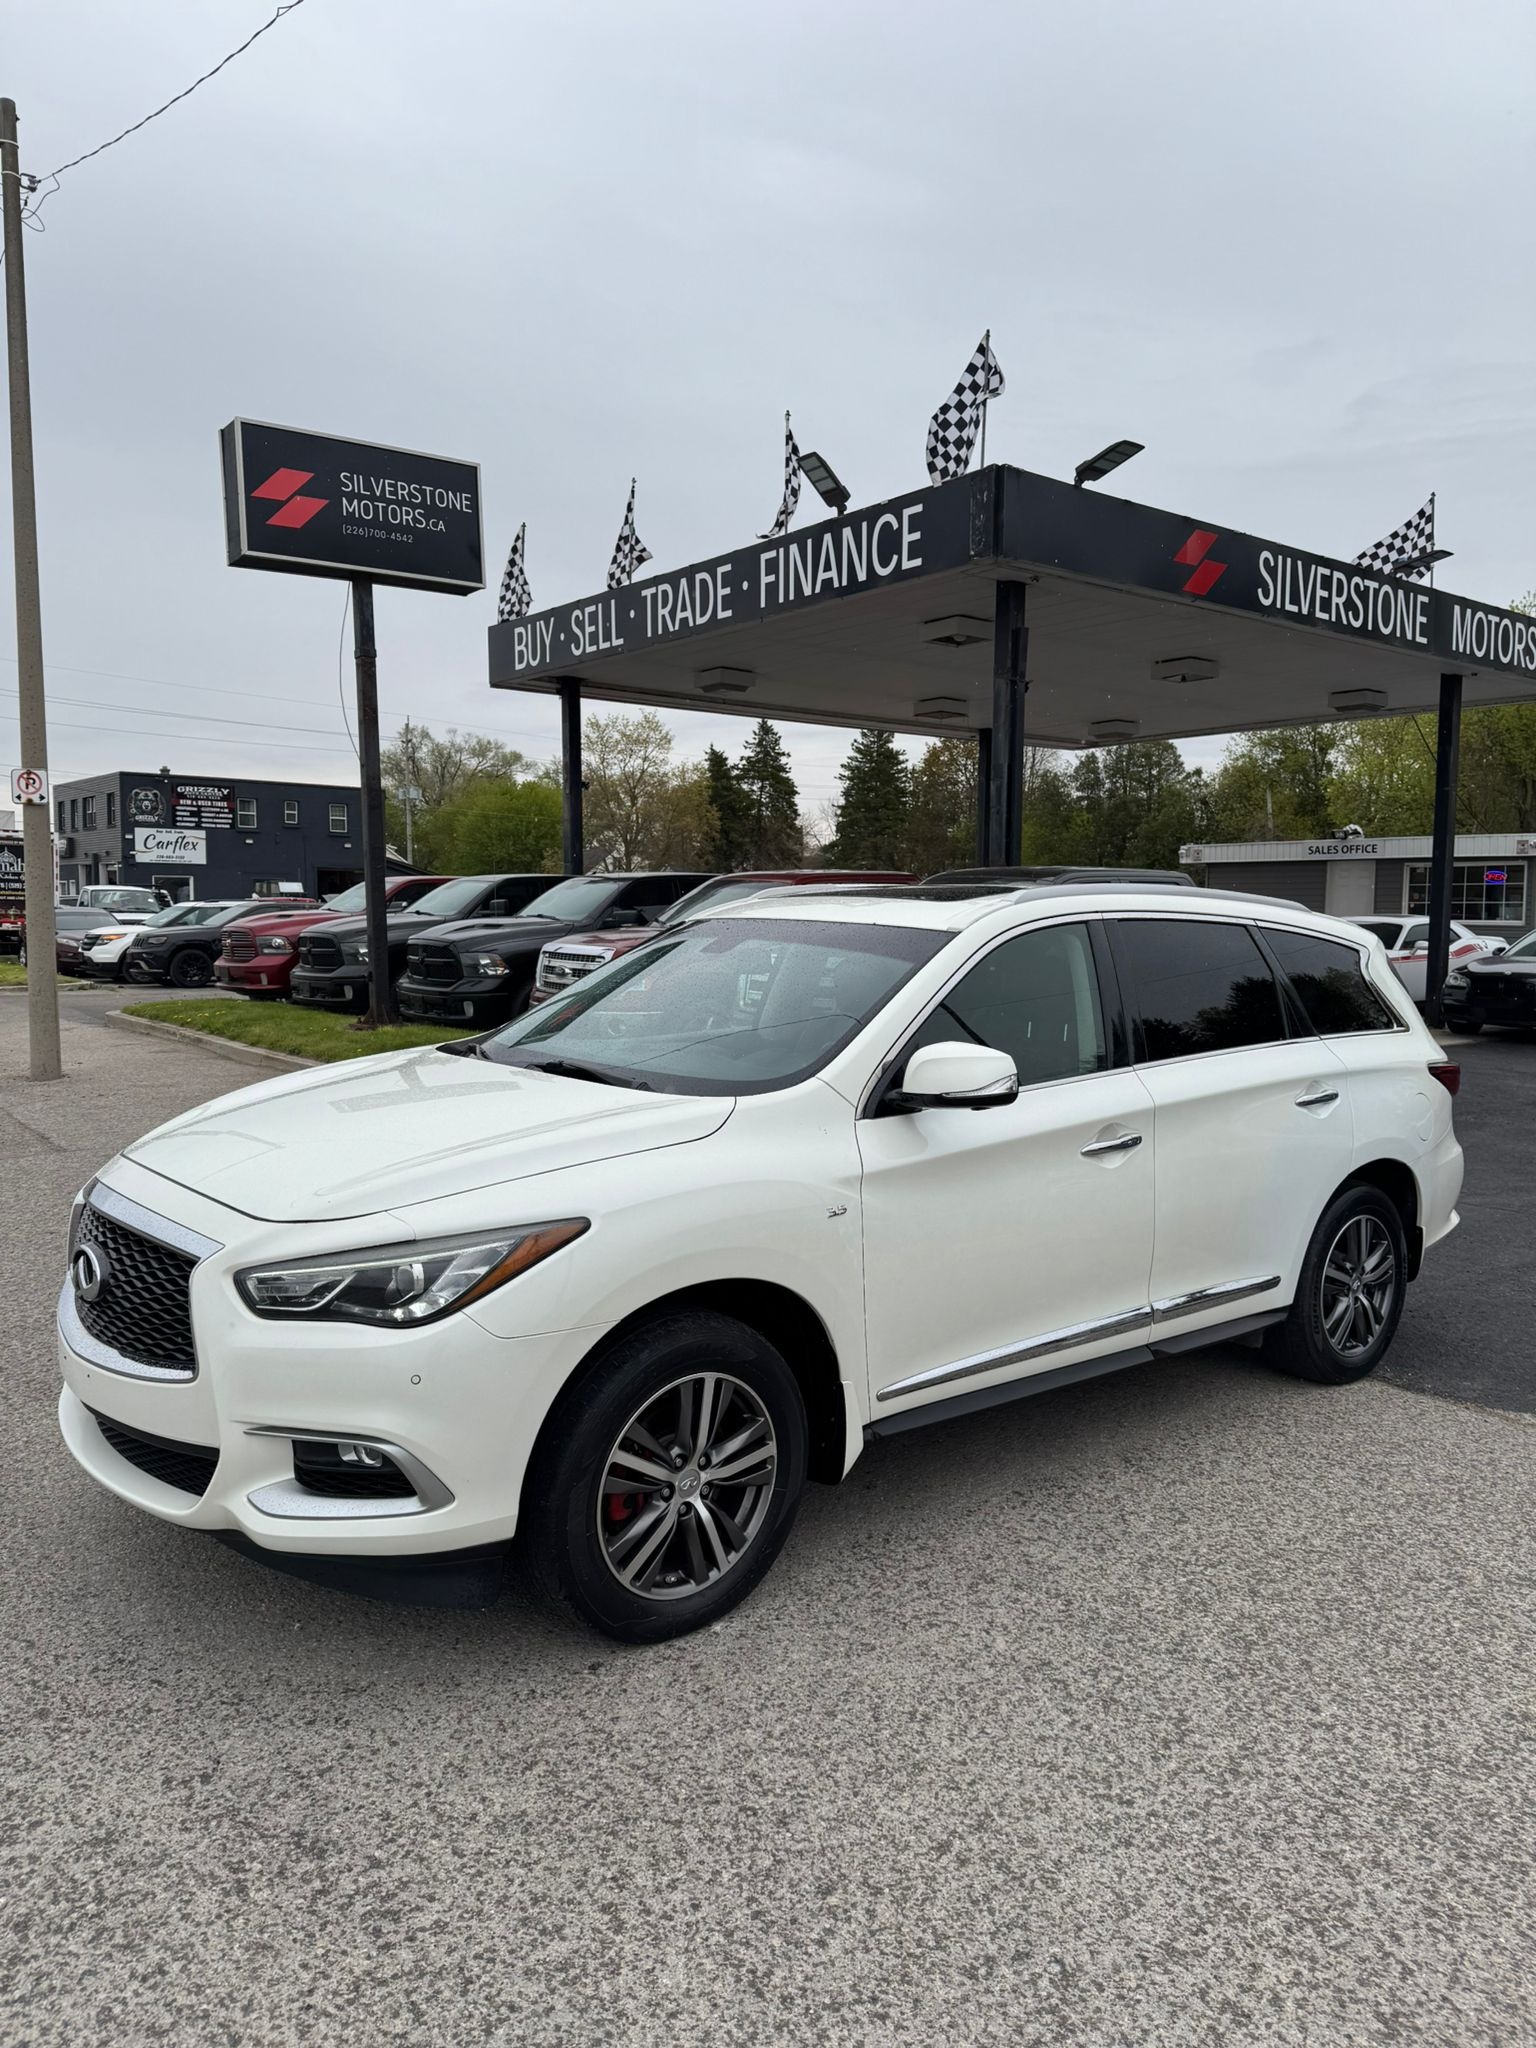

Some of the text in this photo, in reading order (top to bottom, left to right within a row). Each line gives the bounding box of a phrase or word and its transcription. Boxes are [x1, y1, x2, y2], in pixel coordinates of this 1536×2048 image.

[340, 472, 473, 513] SILVERSTONE
[342, 497, 446, 532] MOTORS.CA
[342, 525, 414, 543] (226)700-4542
[513, 504, 924, 671] BUY SELL TRADE FINANCE
[1257, 550, 1536, 671] SILVERSTONE MOTORS
[176, 785, 230, 795] GRIZZLY
[143, 833, 199, 854] Carflex
[1308, 843, 1378, 855] SALES OFFICE
[1485, 872, 1506, 881] OPEN
